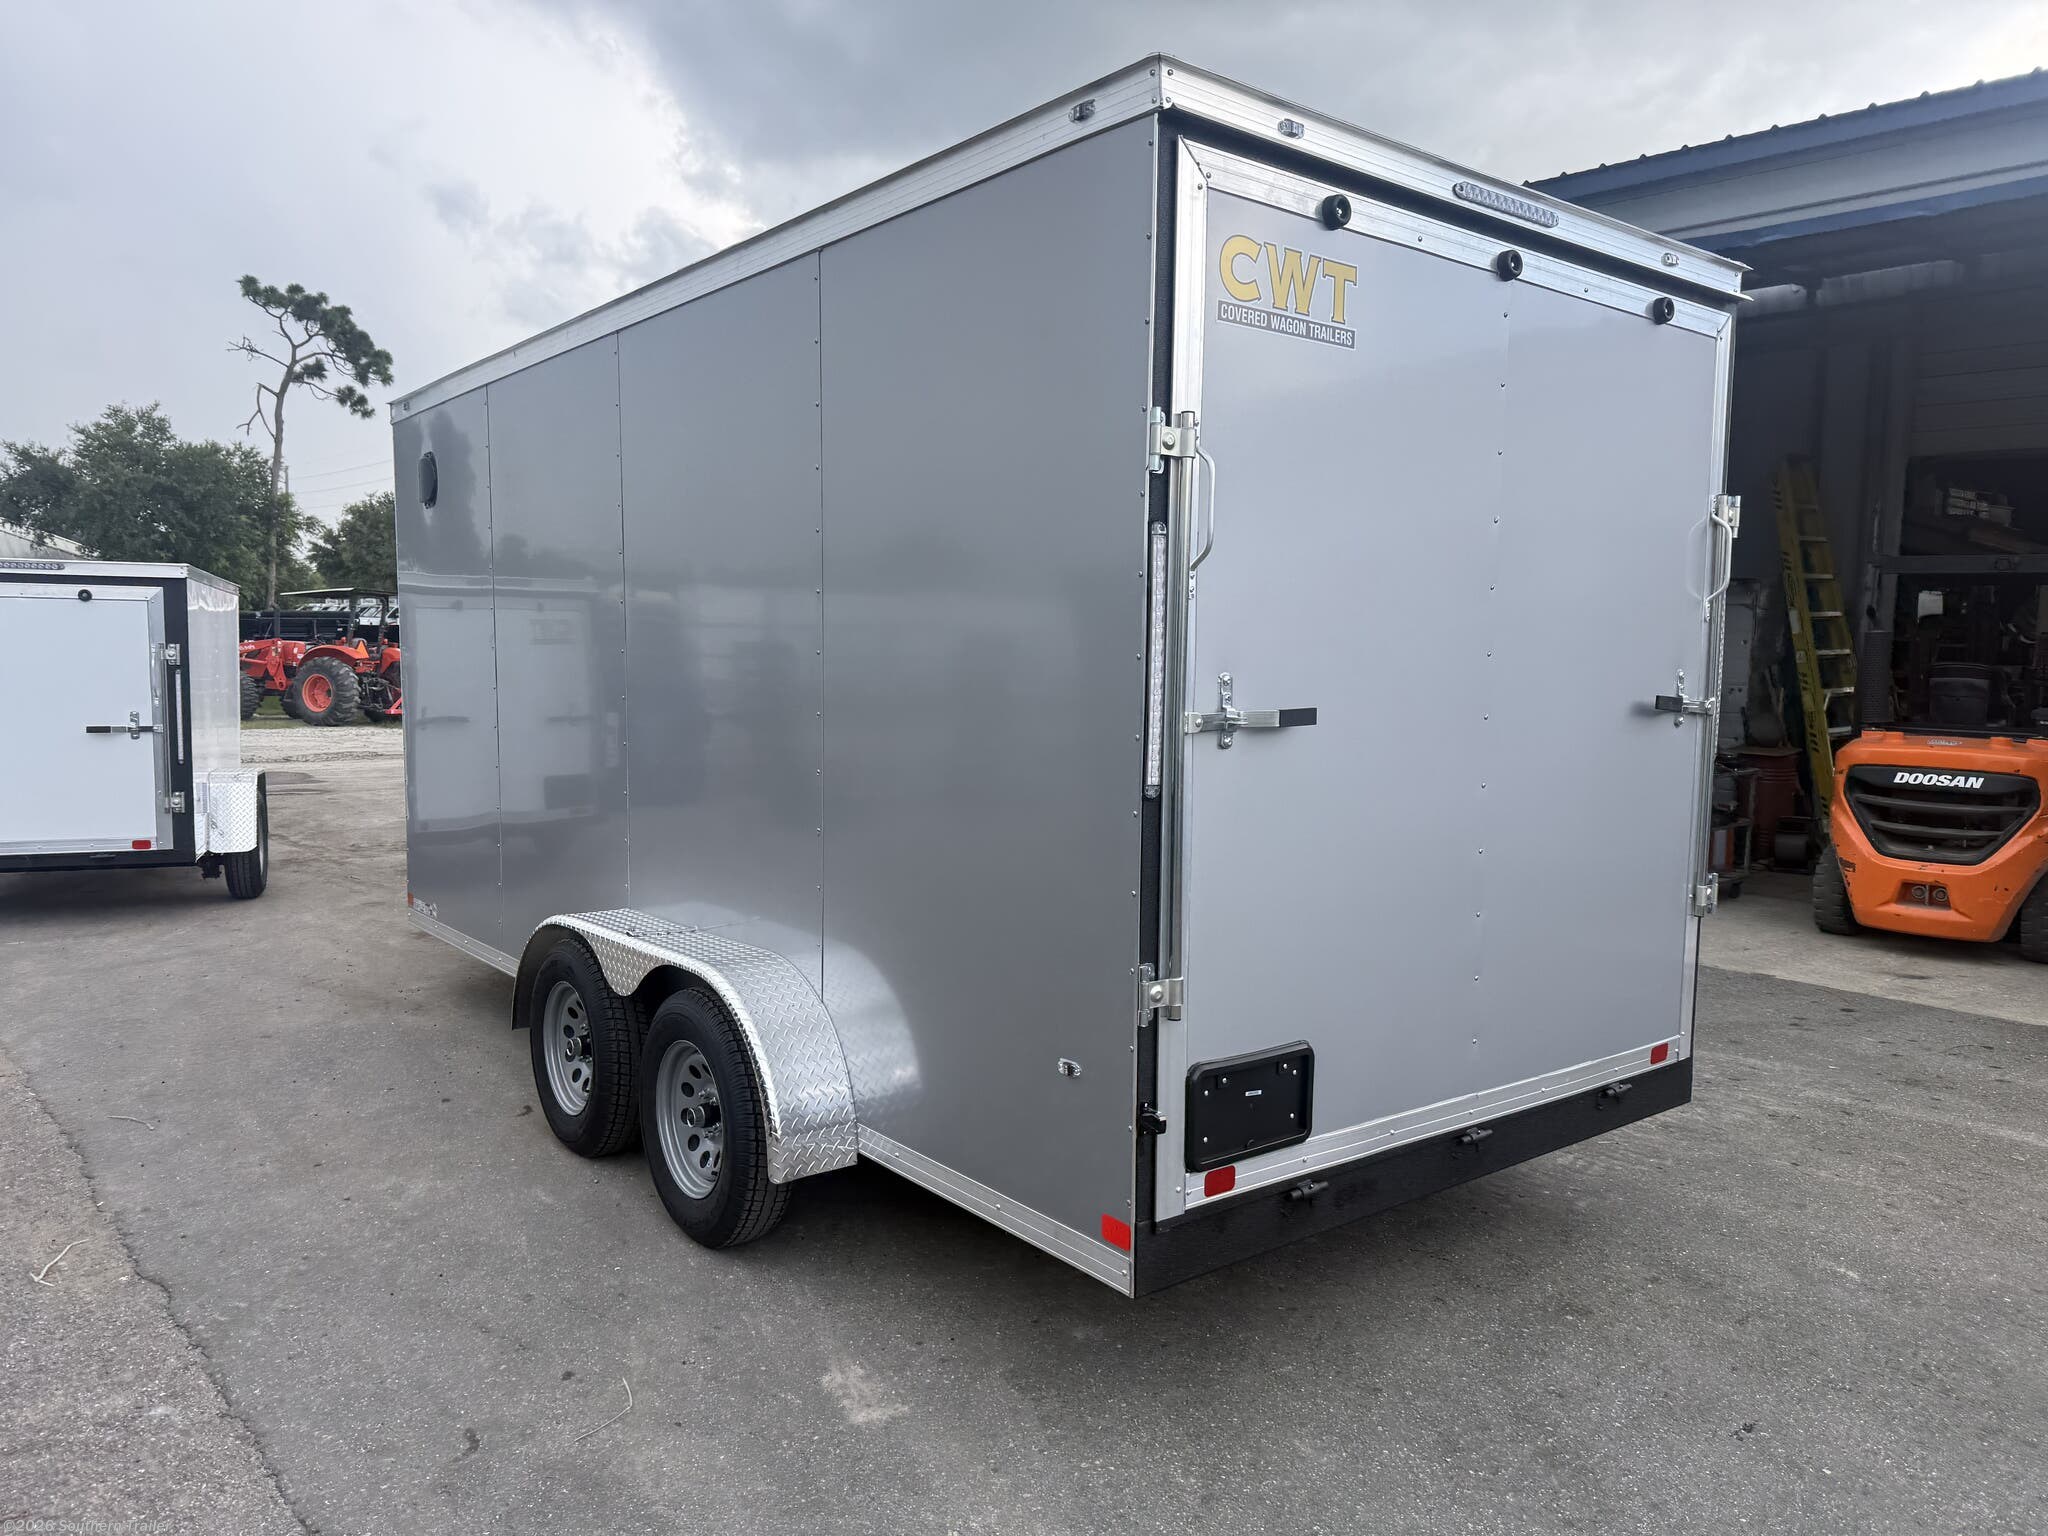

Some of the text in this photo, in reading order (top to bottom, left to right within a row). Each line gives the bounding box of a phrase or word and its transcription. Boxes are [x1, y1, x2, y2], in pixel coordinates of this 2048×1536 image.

[1219, 234, 1358, 325] CWT
[1220, 303, 1353, 346] COVERED WAGON TRAILERS
[1893, 771, 1985, 789] DOOSAN
